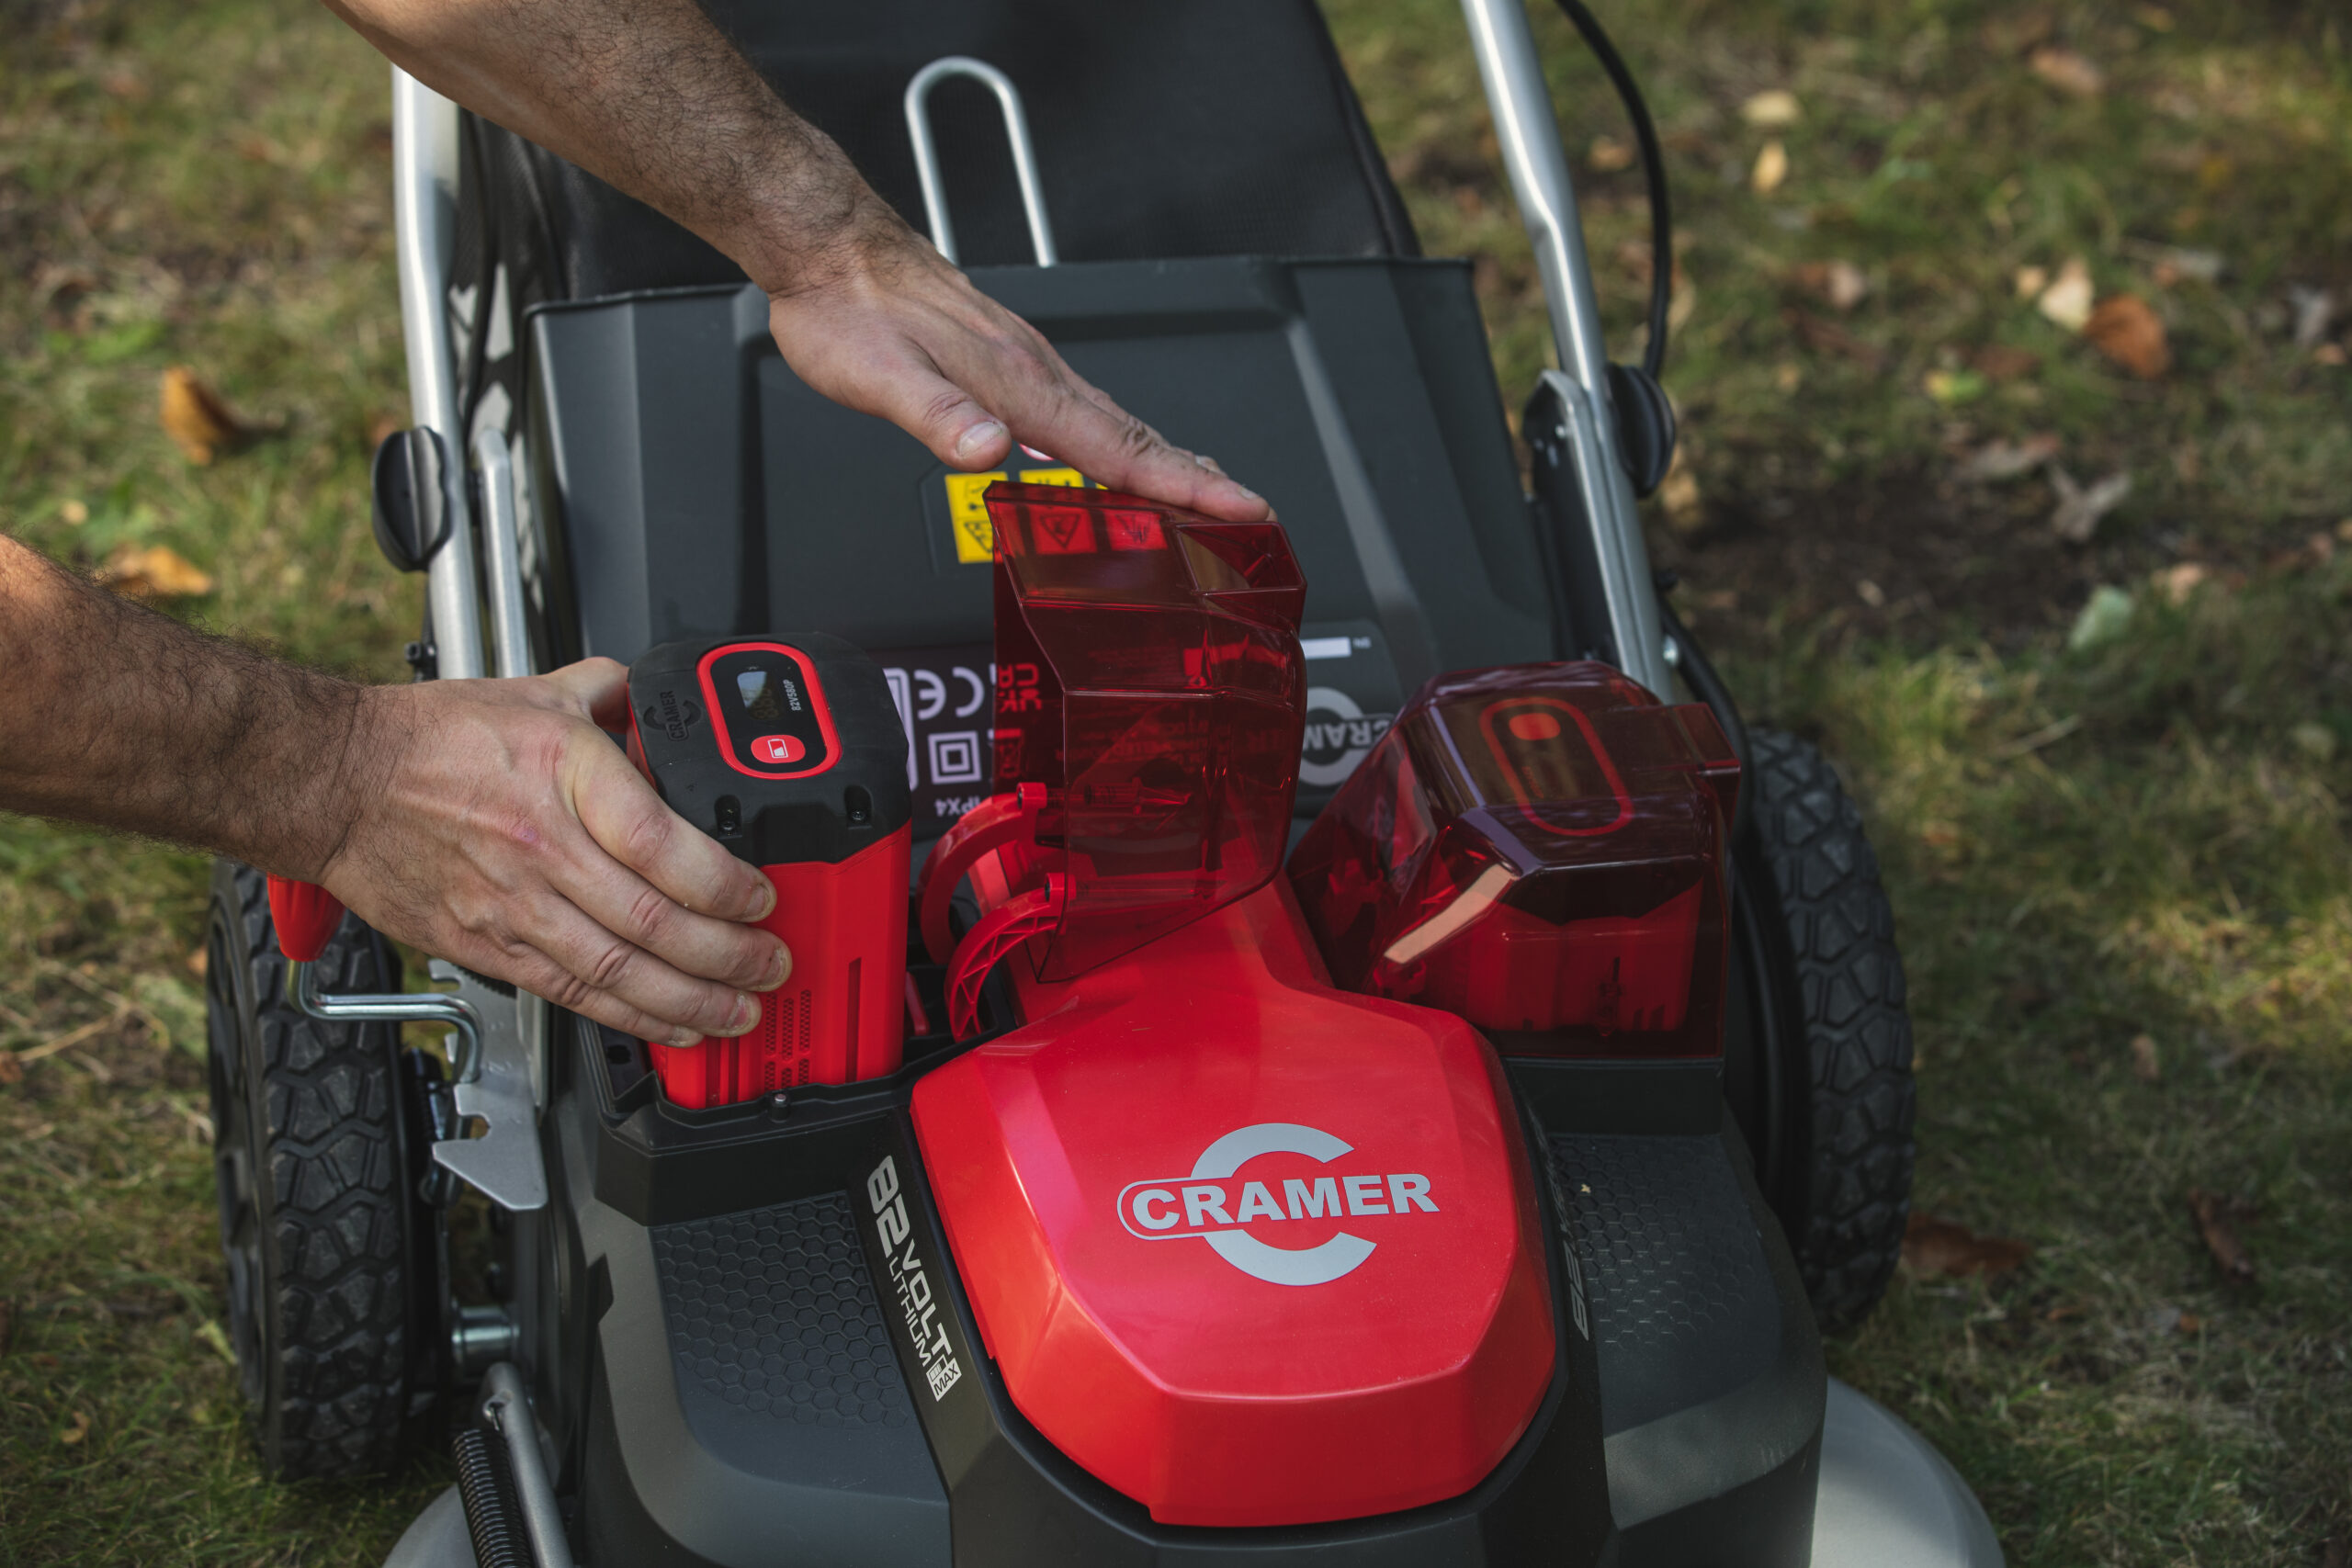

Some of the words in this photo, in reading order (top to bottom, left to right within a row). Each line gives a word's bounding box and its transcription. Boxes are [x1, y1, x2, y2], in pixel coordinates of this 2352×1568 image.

[660, 690, 684, 739] CRAMER
[1132, 1173, 1440, 1230] CRAMER
[867, 1155, 910, 1258] 82
[902, 1238, 952, 1355] VOLT
[888, 1256, 932, 1367] LITHIUM
[933, 1363, 959, 1396] MAX
